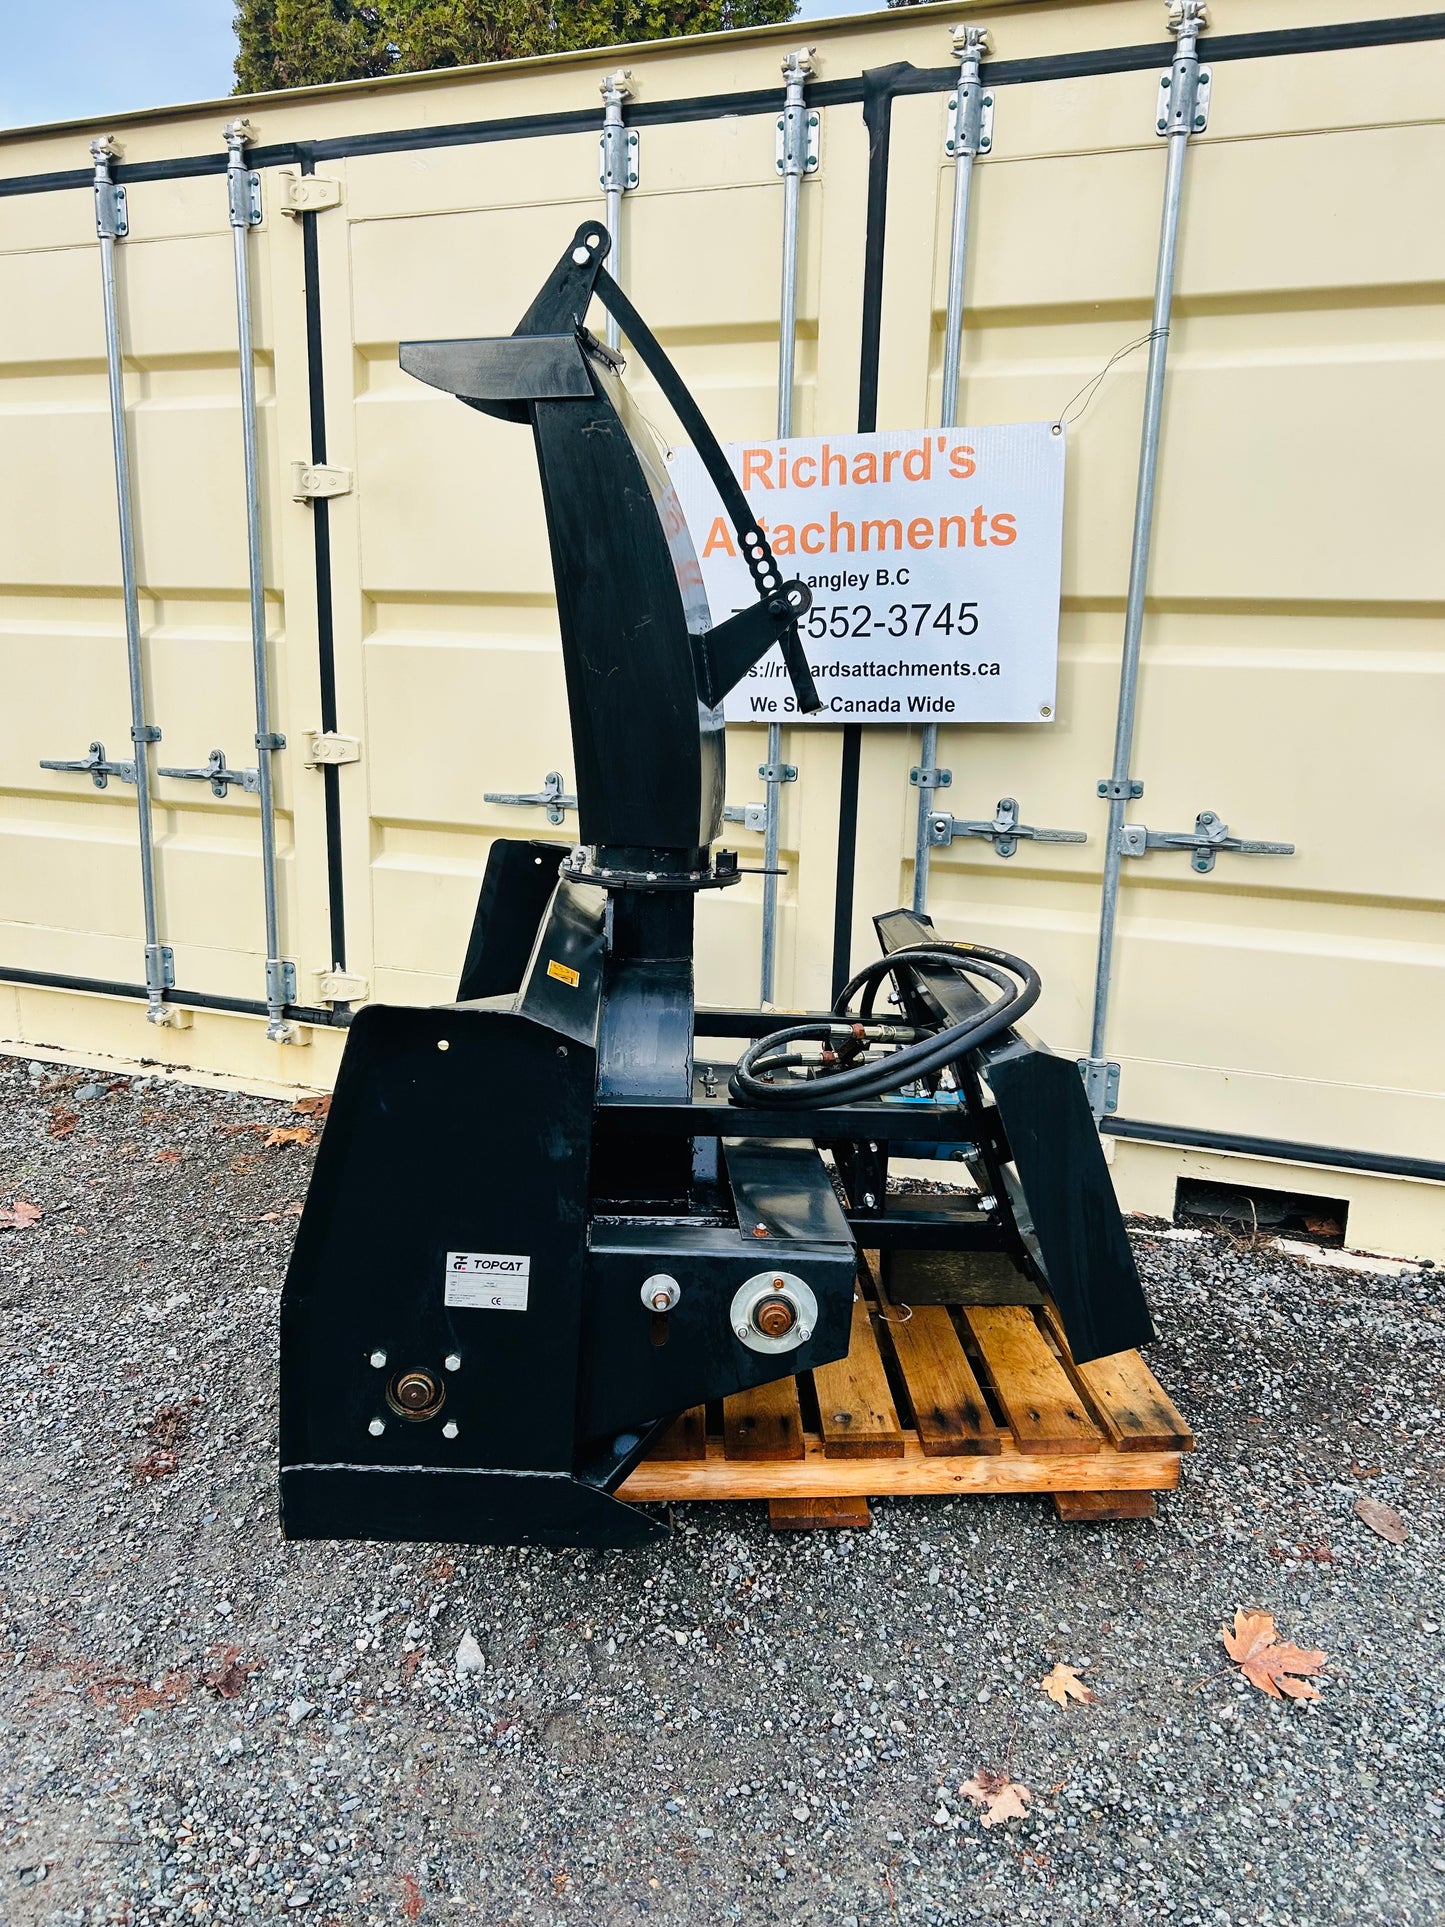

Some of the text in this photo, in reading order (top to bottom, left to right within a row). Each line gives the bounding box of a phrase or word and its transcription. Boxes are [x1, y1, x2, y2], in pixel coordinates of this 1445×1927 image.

[742, 436, 977, 490] Richard's
[702, 505, 1017, 557] Aachments
[876, 568, 910, 586] B.C
[731, 602, 979, 638] -552-3745
[750, 696, 778, 712] We
[830, 696, 901, 713] Canada
[907, 696, 956, 712] Wide
[474, 1260, 523, 1271] TOPCAT
